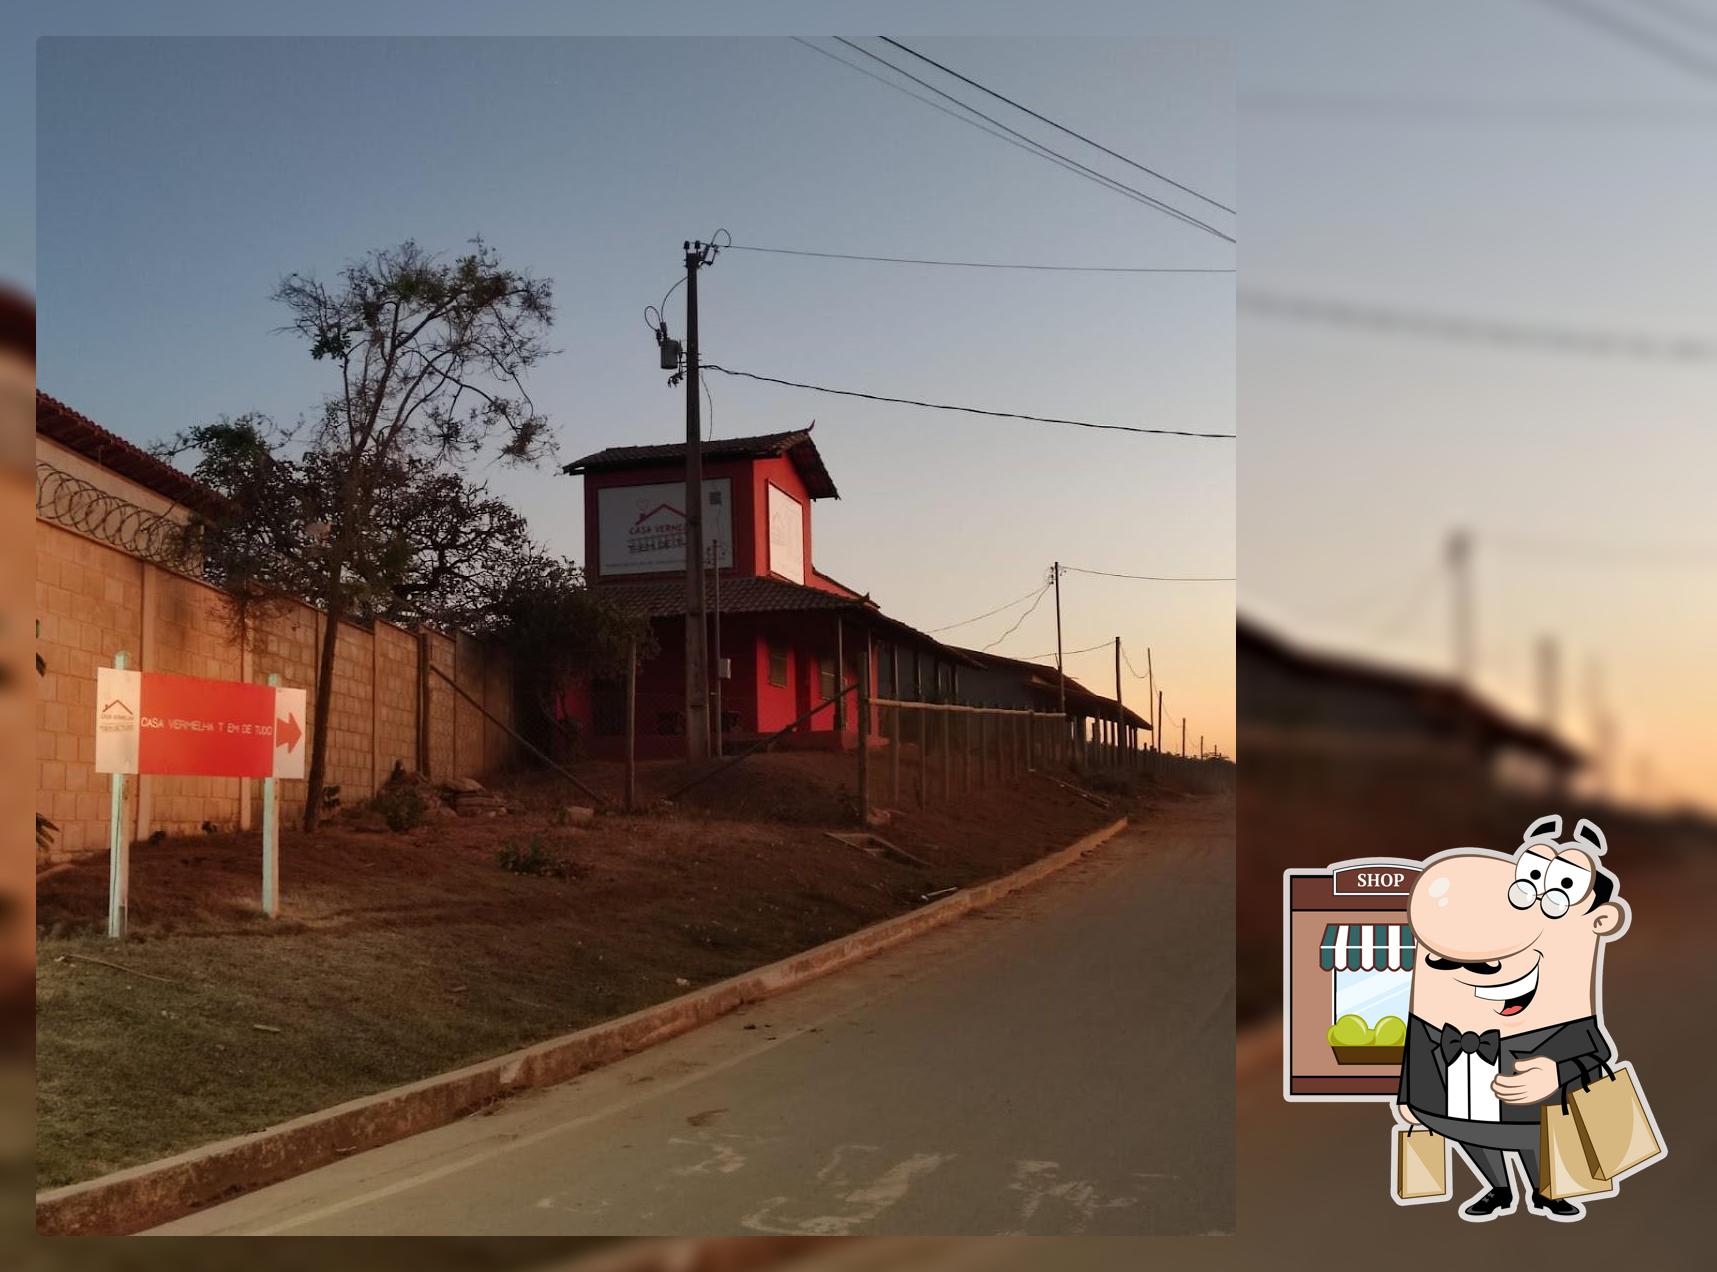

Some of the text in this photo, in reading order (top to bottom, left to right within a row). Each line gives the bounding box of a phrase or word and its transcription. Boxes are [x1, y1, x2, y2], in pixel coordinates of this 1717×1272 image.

[140, 717, 164, 728] CASA
[168, 719, 214, 732] VERMELHA
[255, 724, 273, 736] TUDO
